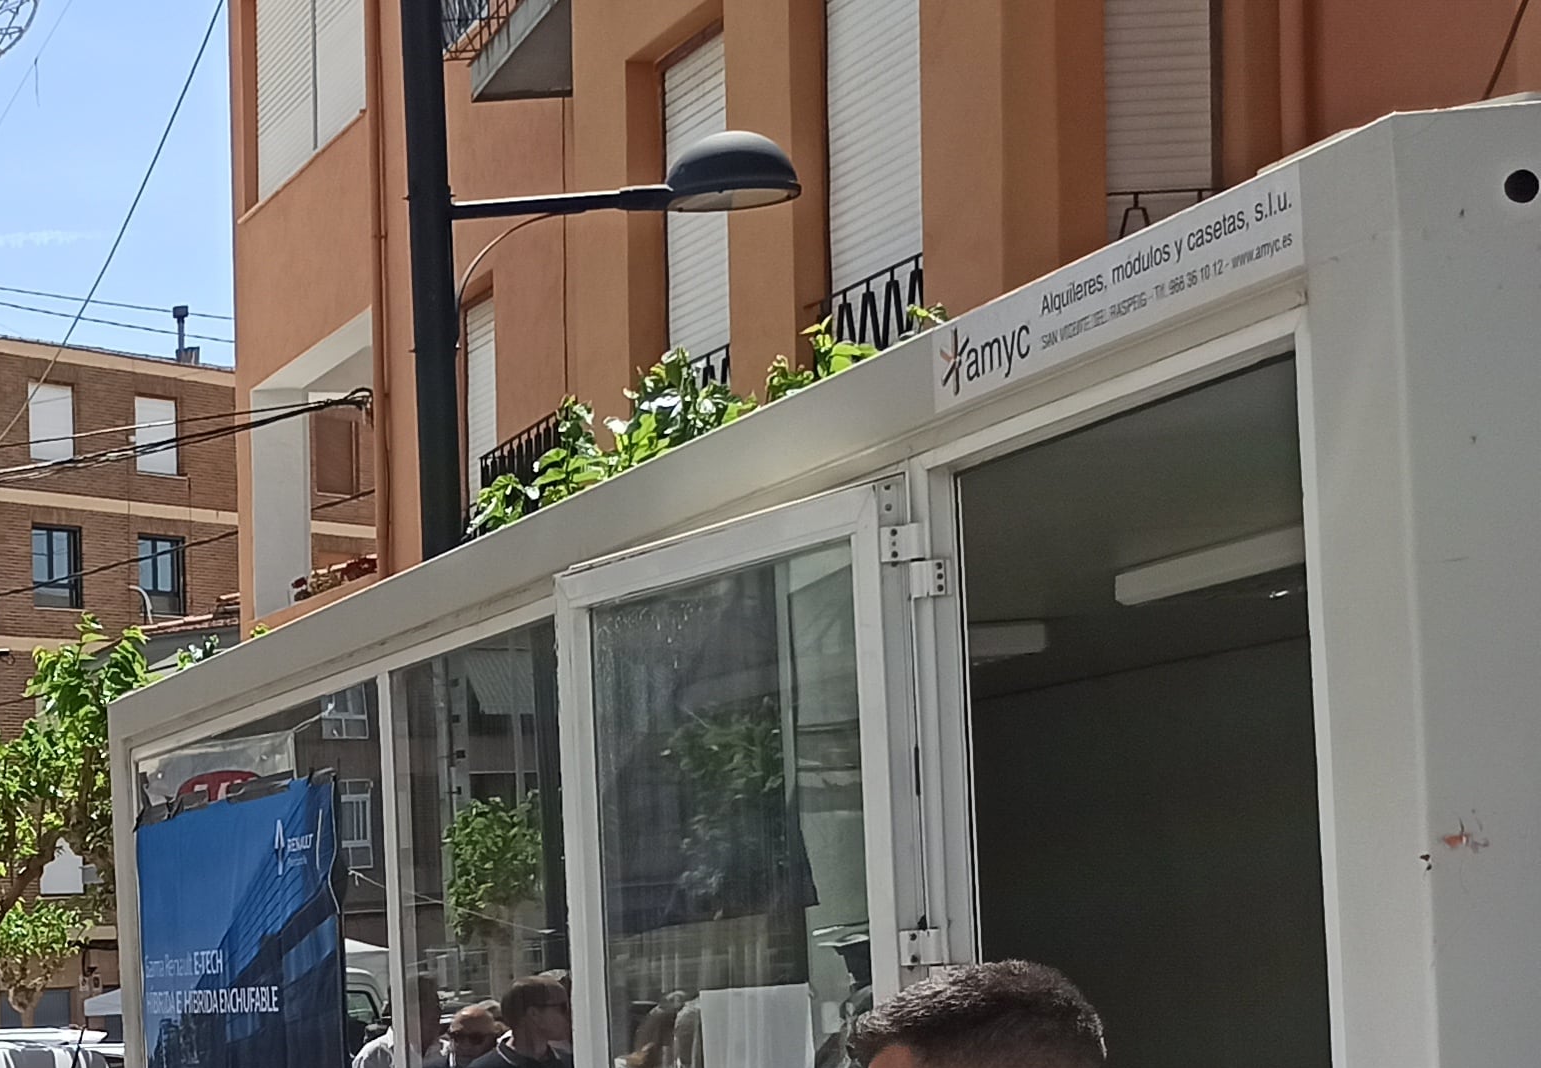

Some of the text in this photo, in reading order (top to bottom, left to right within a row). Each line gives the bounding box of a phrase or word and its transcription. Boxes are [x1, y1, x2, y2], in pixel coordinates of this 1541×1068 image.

[1040, 191, 1292, 317] Alquileres, módulos y casetas, s.l.u.
[1041, 330, 1058, 350] SAN
[1200, 264, 1210, 282] 10
[1213, 259, 1223, 277] 12
[966, 324, 1031, 381] amyc
[193, 949, 223, 976] E-TECH
[219, 985, 279, 1013] ENCHUFABLE
